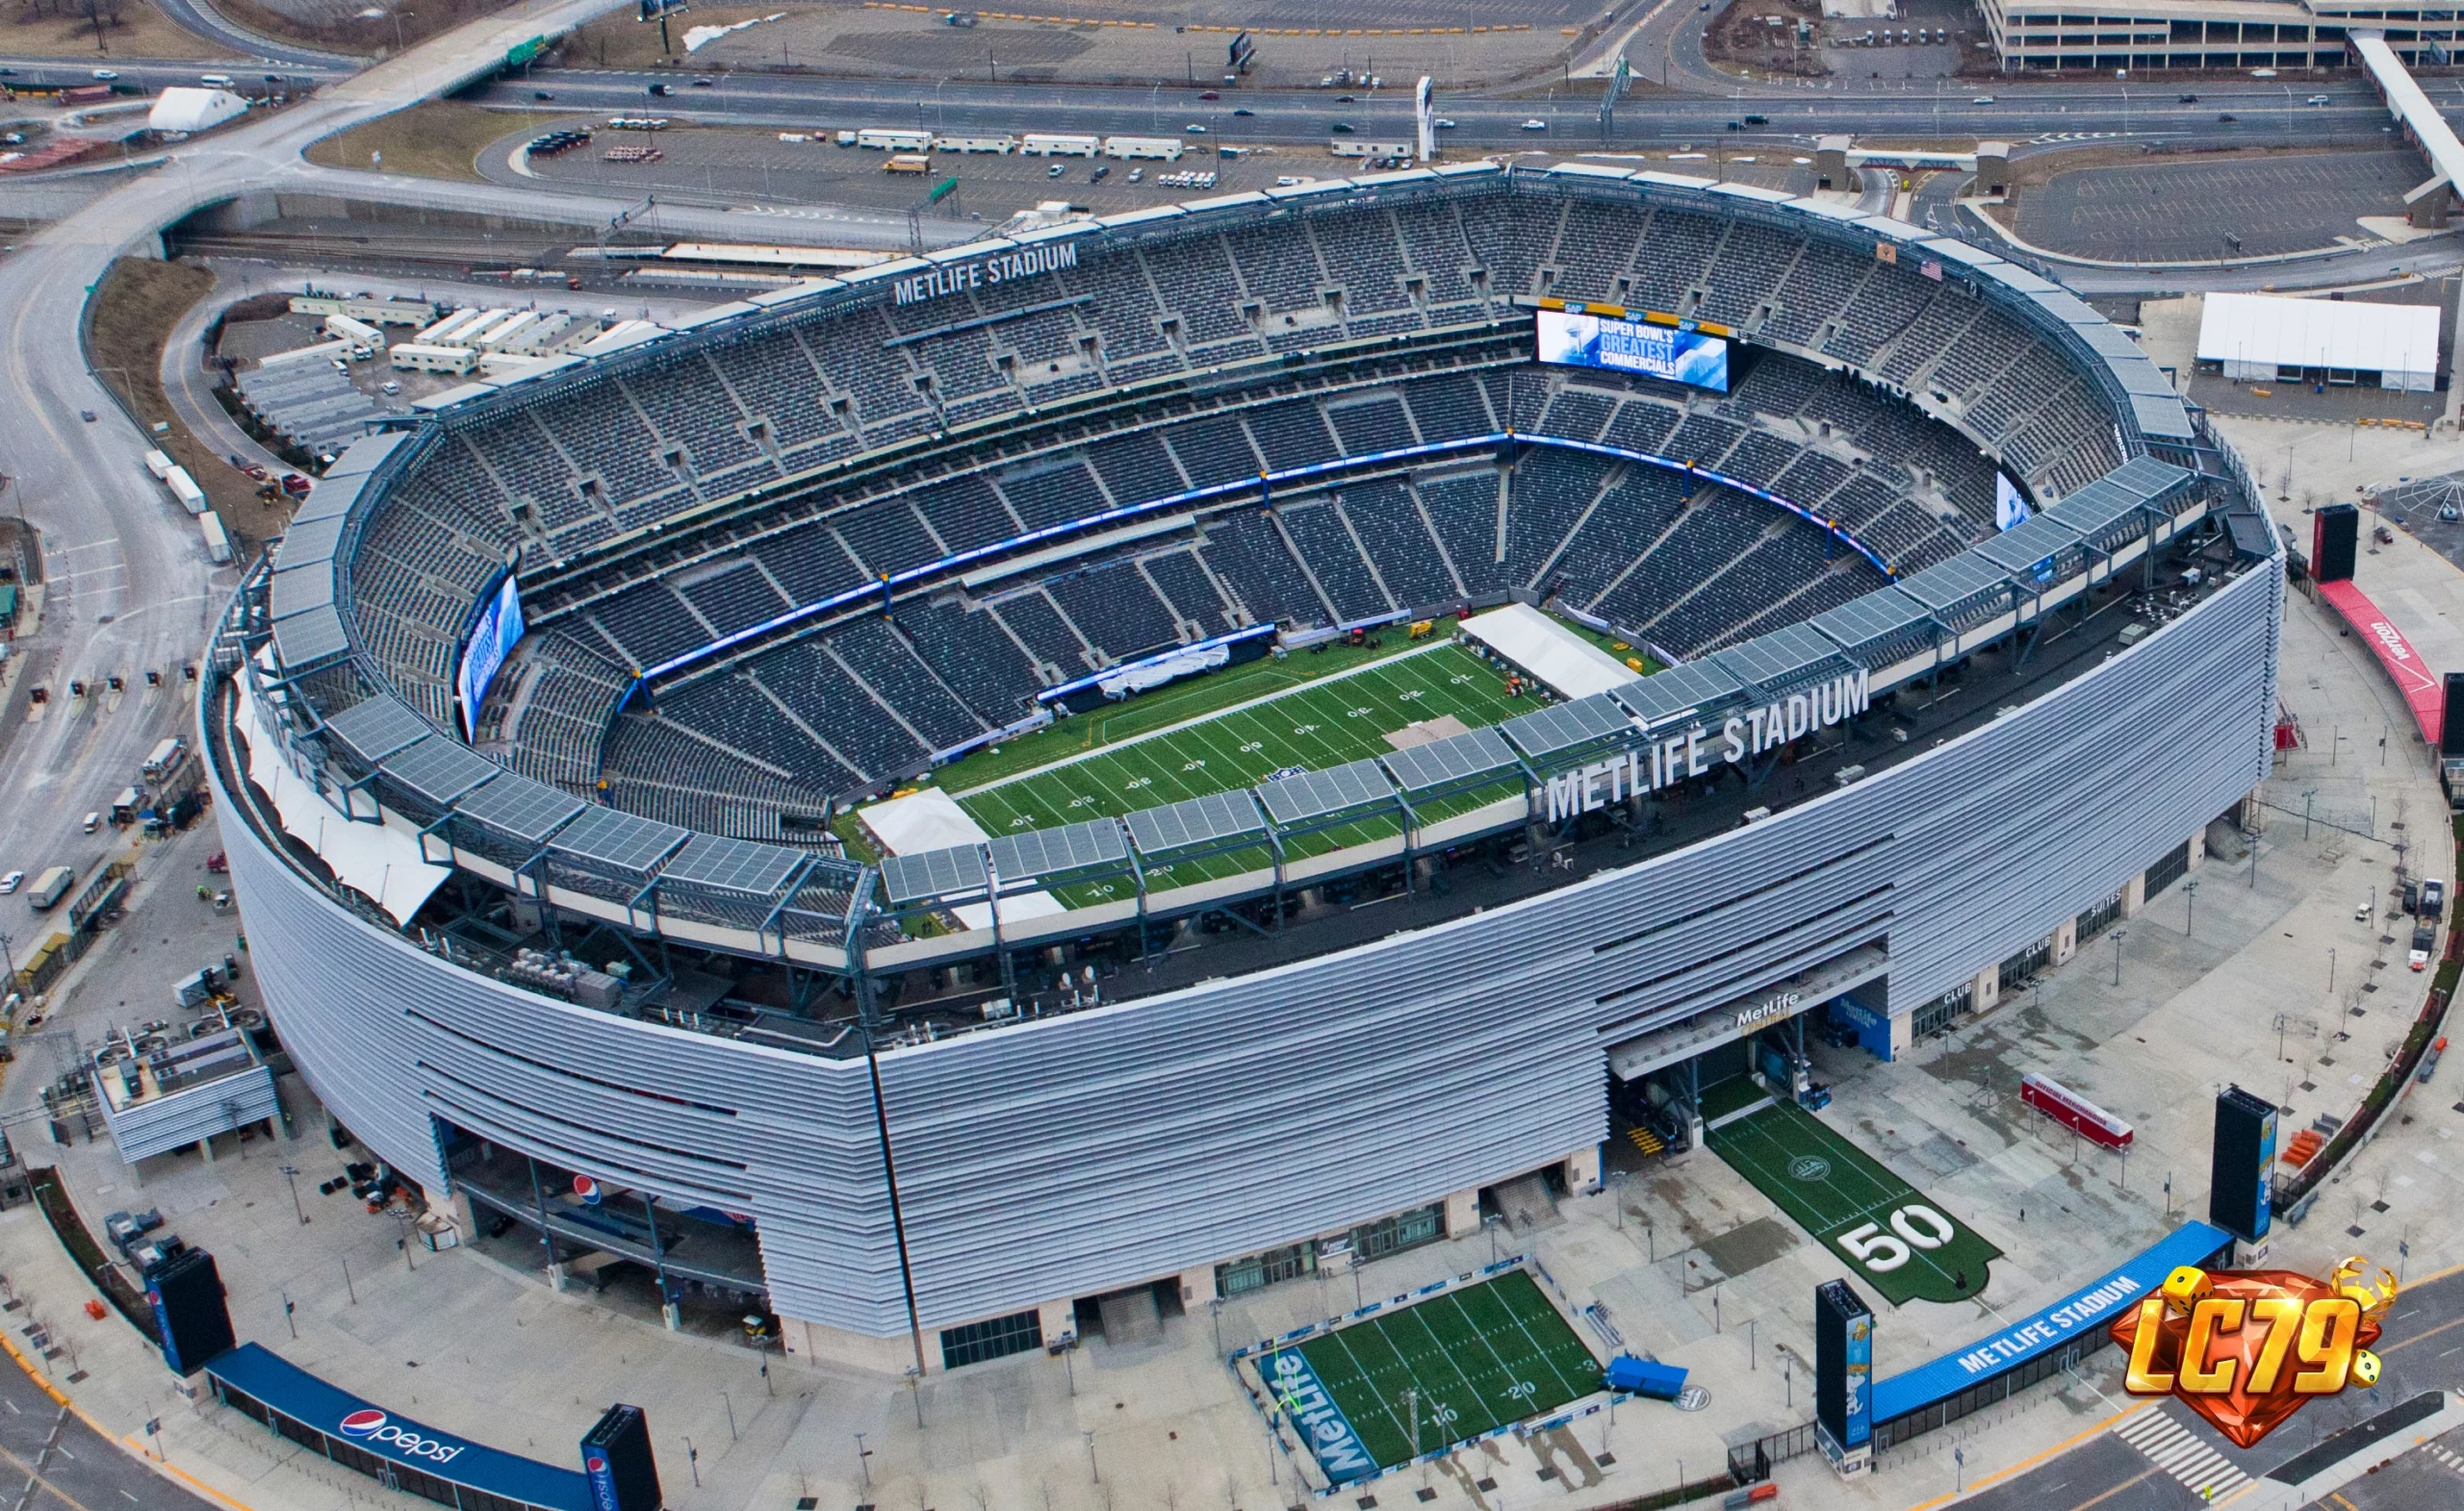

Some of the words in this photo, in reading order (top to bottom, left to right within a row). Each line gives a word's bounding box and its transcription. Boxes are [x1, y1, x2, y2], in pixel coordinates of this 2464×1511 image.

[894, 264, 982, 305] METLIFE
[988, 243, 1077, 283] STADIUM
[1565, 303, 1582, 314] SAP
[1626, 312, 1642, 322] SAP
[1600, 319, 1633, 336] SUPER
[1636, 323, 1674, 344] BOWL'S
[1679, 320, 1695, 331] SAP
[1600, 333, 1675, 361] GREATEST
[1600, 352, 1677, 375] COMMERCIALS
[2371, 622, 2410, 660] verizon
[1547, 728, 1708, 824] METLIFE
[1723, 668, 1869, 763] STADIUM
[1091, 884, 1115, 898] 10
[2091, 888, 2121, 918] SUITES
[2025, 935, 2051, 958] CLUB
[1943, 982, 1972, 1005] CLUB
[1736, 992, 1799, 1027] MetLife
[2035, 1081, 2063, 1100] OFFICIAL
[1836, 1204, 1954, 1272] 50
[1957, 1319, 2058, 1374] METLIFE
[2049, 1275, 2142, 1329] STADIUM
[1507, 1380, 1536, 1400] 20
[1270, 1355, 1370, 1473] MetLife
[1430, 1408, 1459, 1427] 10
[367, 1425, 465, 1464] pepsi
[595, 1479, 614, 1511] epsi
